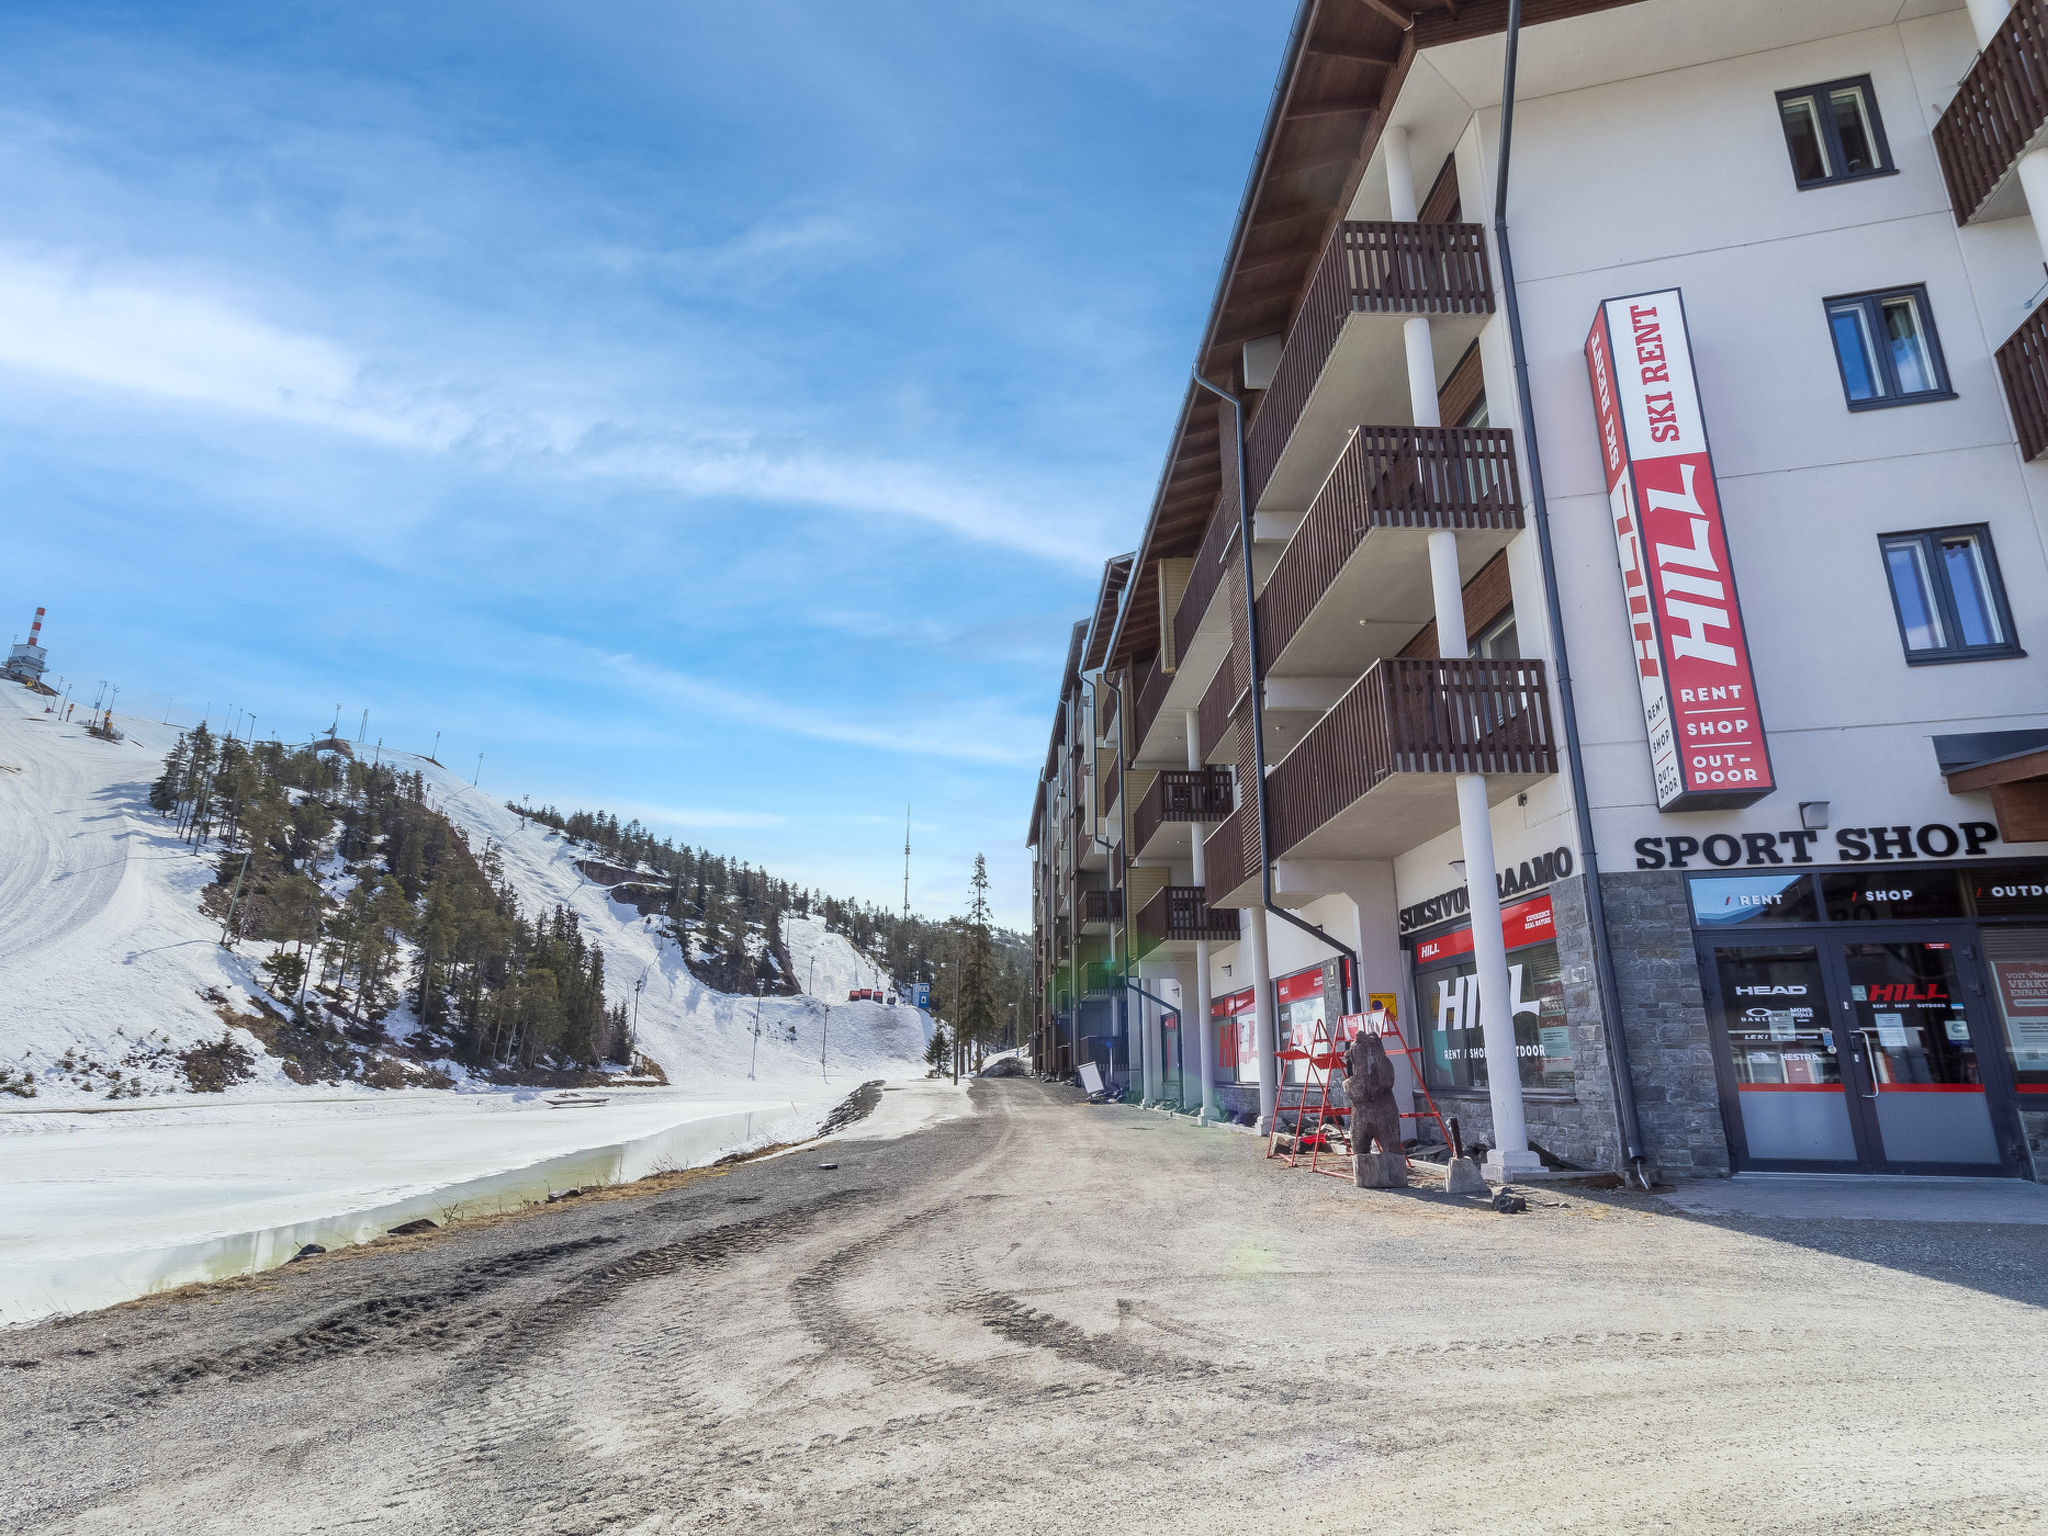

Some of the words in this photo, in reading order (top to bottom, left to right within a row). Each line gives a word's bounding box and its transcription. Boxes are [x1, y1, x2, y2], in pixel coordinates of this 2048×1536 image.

[1629, 304, 1670, 386] RENT
[1591, 331, 1611, 416] RENT
[1645, 391, 1680, 443] SKI
[1605, 413, 1620, 471] SKI
[1646, 463, 1738, 667] HILL
[1616, 483, 1660, 681] HILL
[1680, 684, 1742, 703] RENT
[1647, 696, 1664, 722] RENT
[1686, 719, 1749, 736] SHOP
[1653, 729, 1670, 753] SHOP
[1692, 754, 1751, 768] OUT-
[1657, 766, 1674, 784] OUT-
[1694, 769, 1758, 784] DOOR
[1660, 777, 1678, 799] DOOR
[1634, 829, 1818, 869] SPORT
[1835, 822, 1998, 861] SHOP
[1739, 894, 1784, 906] RENT
[1865, 889, 1914, 901] SHOP
[1421, 943, 1440, 958] HILL
[1438, 963, 1541, 1032] HIL
[1735, 985, 1808, 996] HEAD
[1868, 983, 1949, 1001] HILL
[1443, 1048, 1461, 1060] RENT
[1469, 1047, 1487, 1059] SHO
[1780, 1052, 1822, 1061] HESTRA
